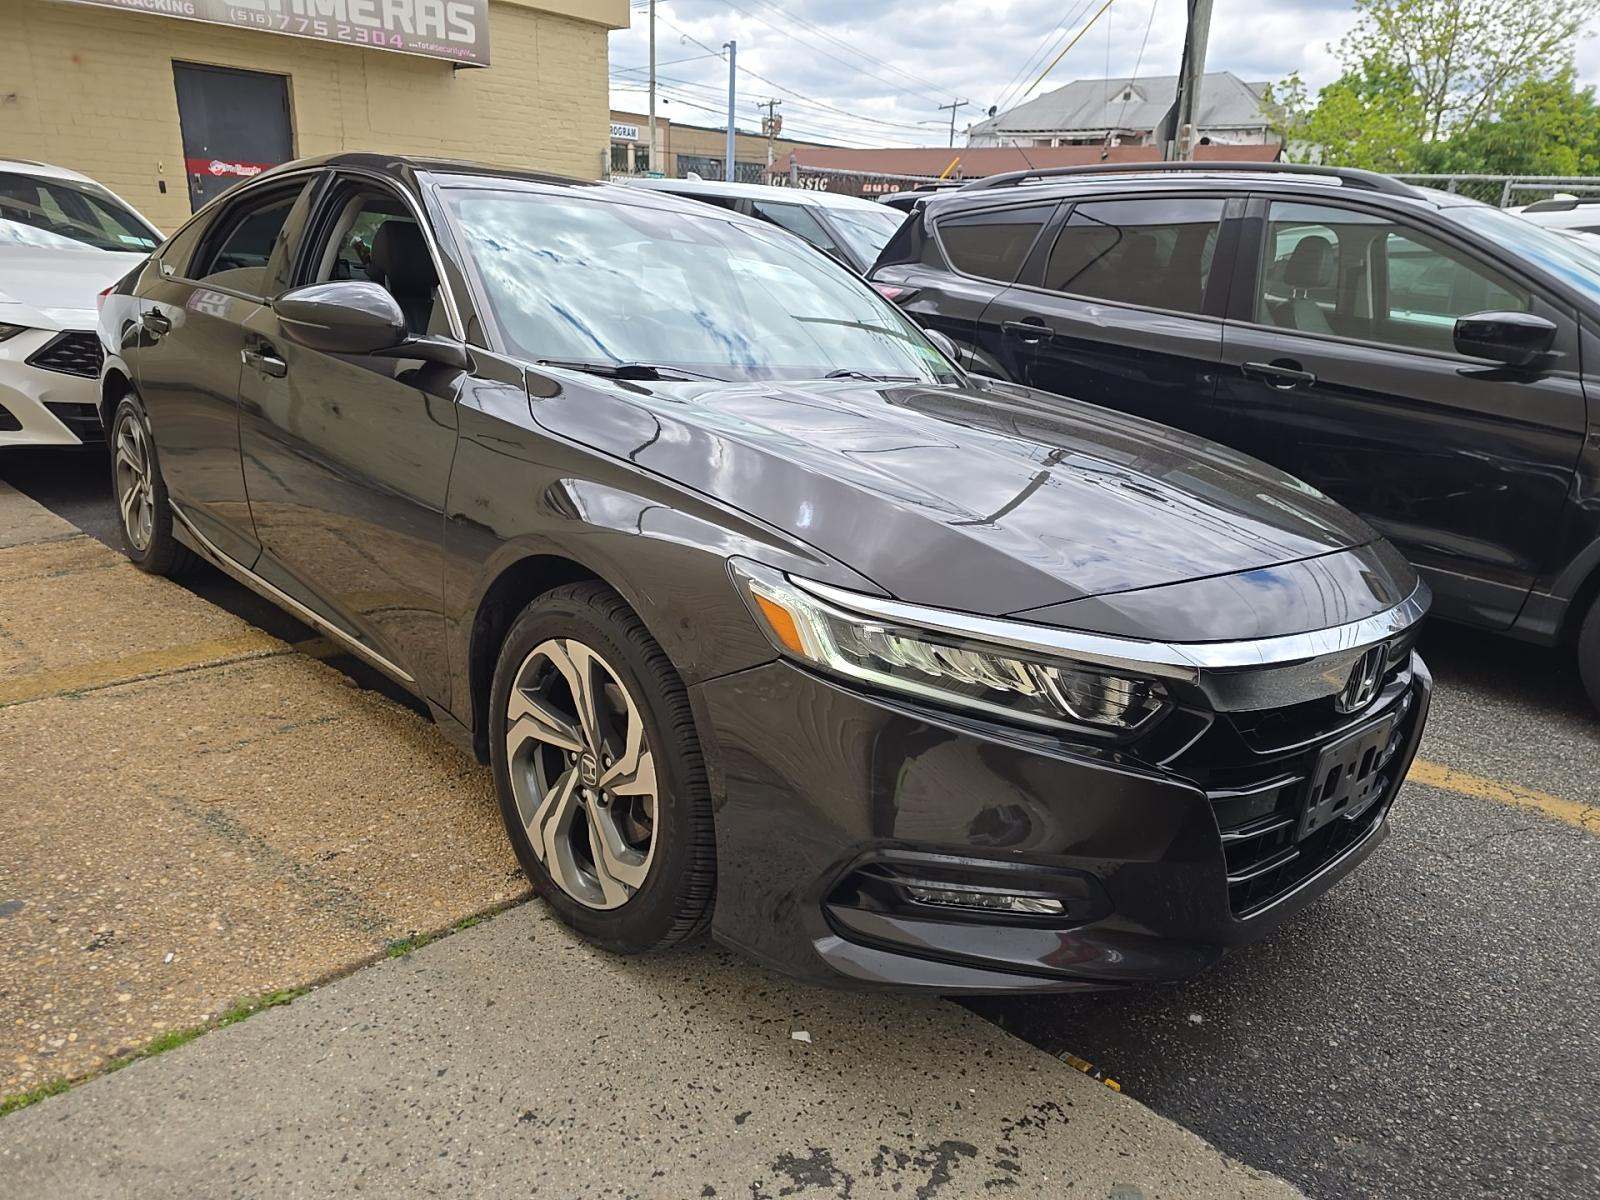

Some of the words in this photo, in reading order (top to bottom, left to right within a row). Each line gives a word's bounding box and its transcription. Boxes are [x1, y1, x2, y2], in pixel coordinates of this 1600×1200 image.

[112, 0, 195, 15] ACKING
[230, 8, 272, 28] (516)
[276, 14, 328, 37] 775
[336, 24, 404, 49] 2304
